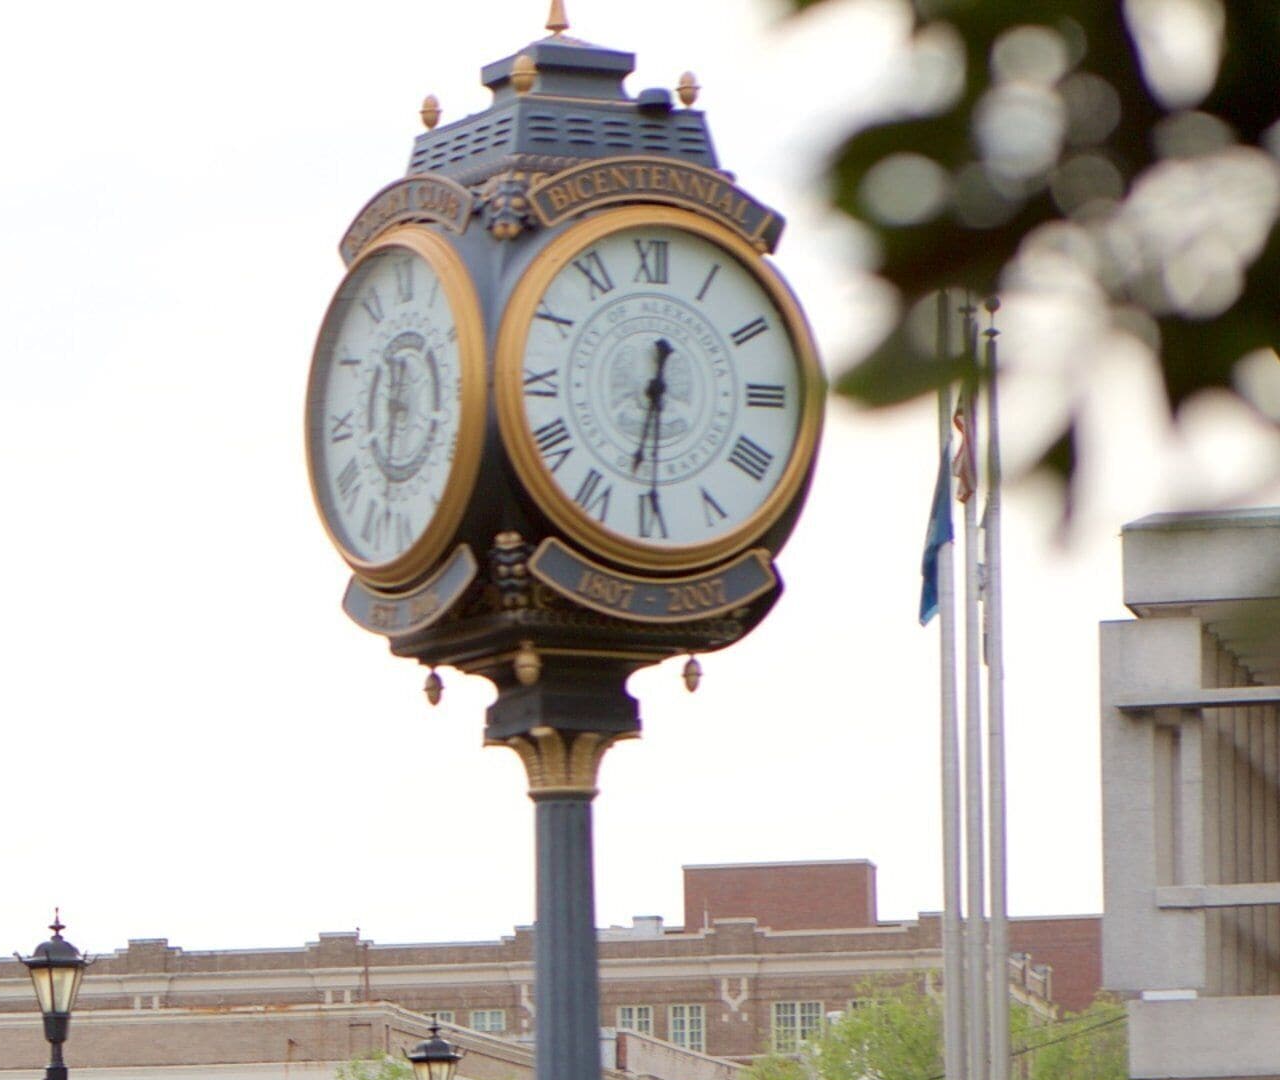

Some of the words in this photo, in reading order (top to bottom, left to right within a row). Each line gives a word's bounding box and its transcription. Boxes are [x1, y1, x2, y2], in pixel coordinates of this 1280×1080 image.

[547, 166, 749, 224] BICENTENNIAL
[579, 570, 635, 609] 1807
[666, 579, 726, 612] 2007
